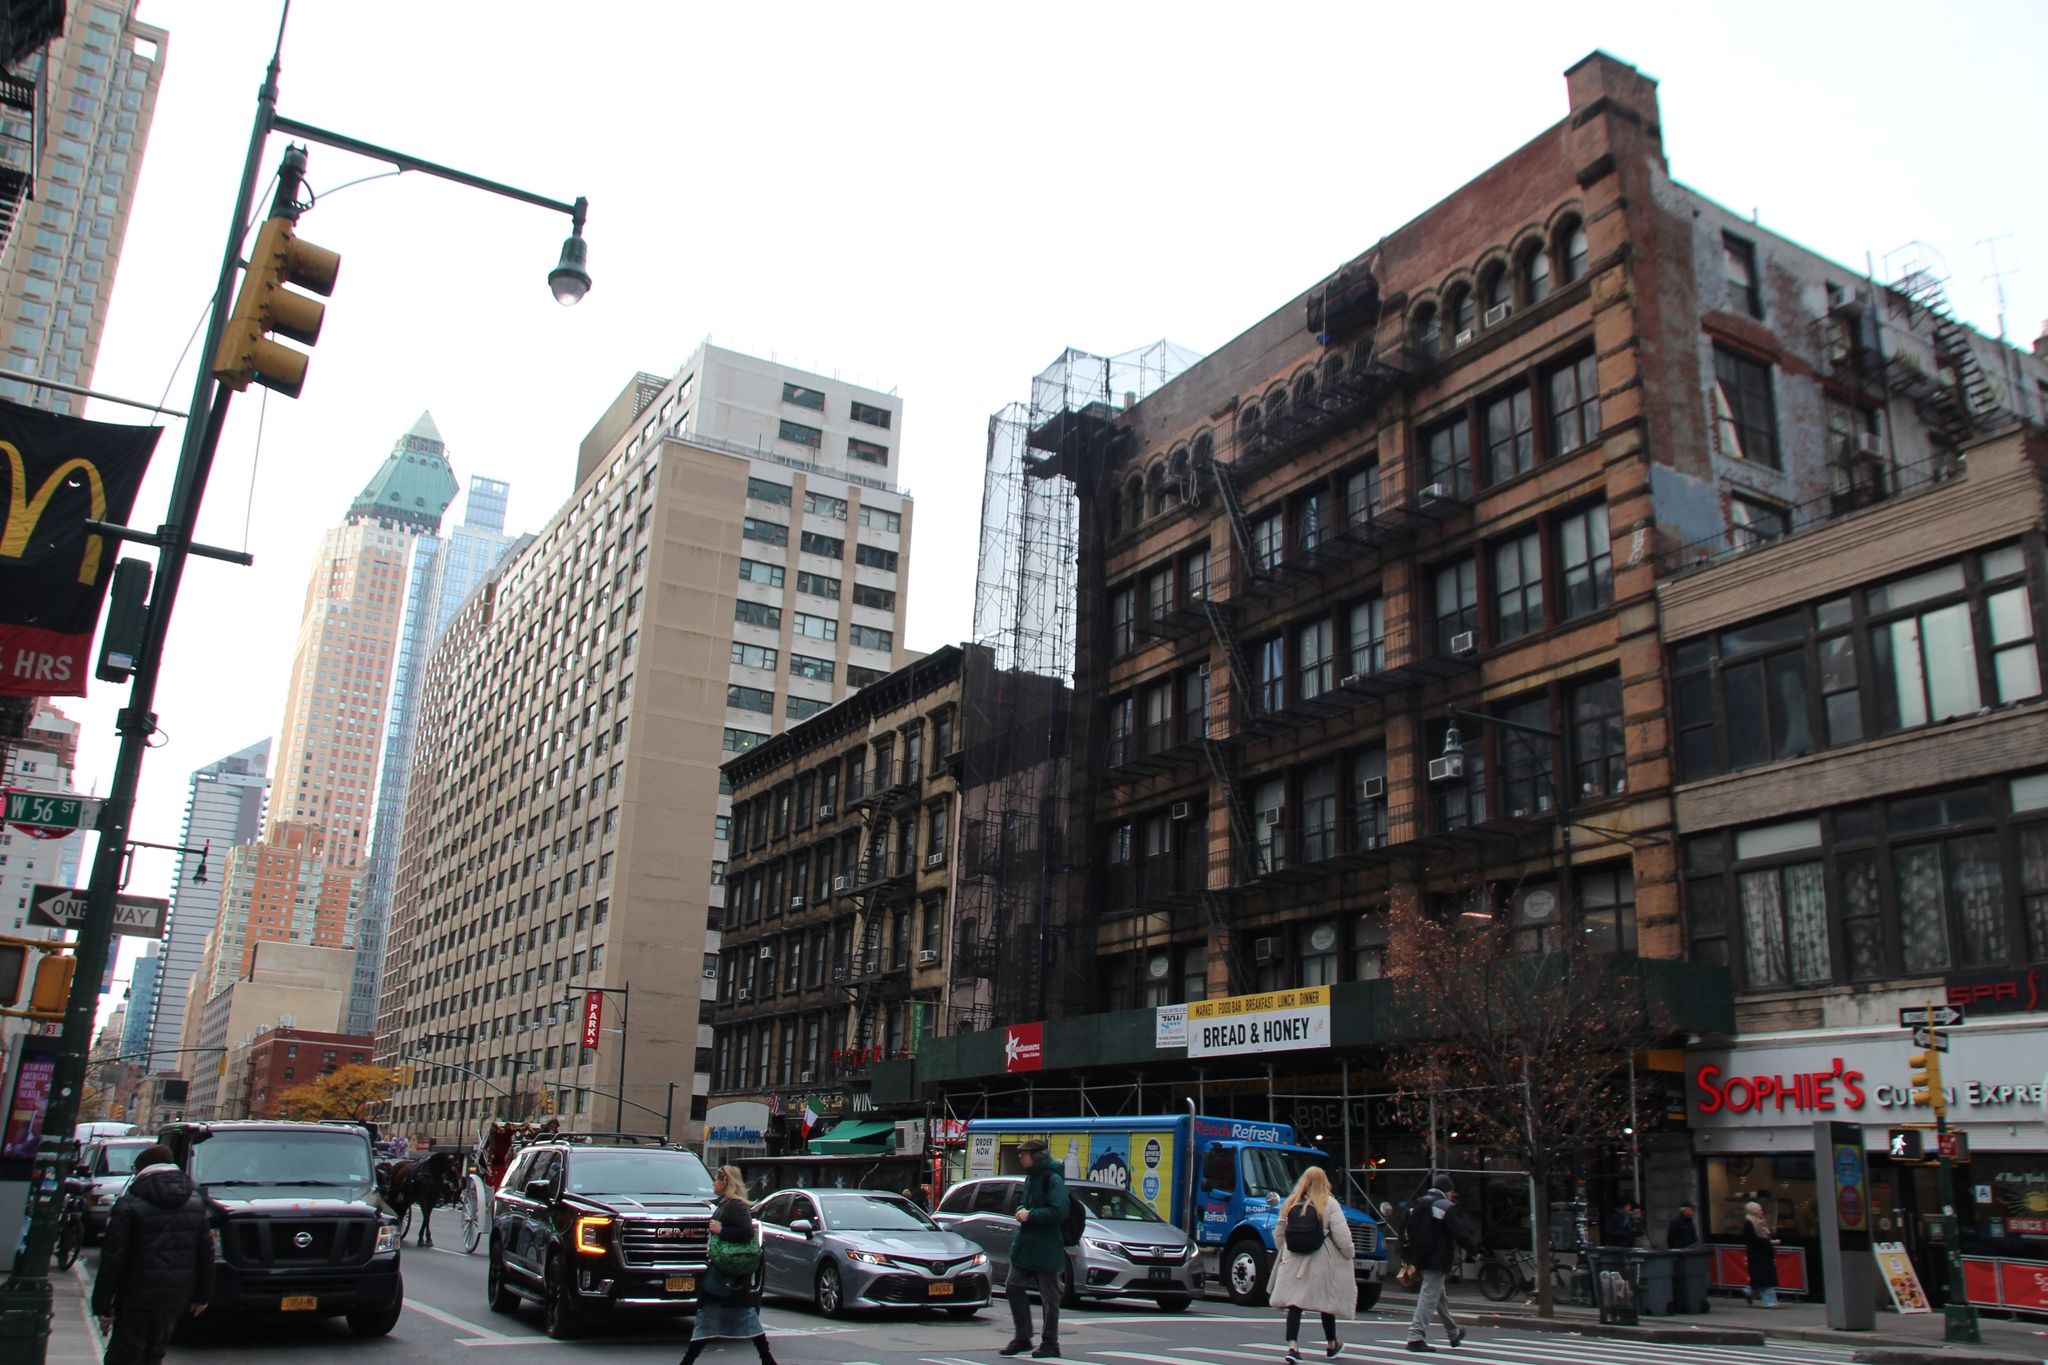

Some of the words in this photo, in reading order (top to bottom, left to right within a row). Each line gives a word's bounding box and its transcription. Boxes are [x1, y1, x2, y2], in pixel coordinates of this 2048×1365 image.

[13, 649, 73, 681] HRS
[11, 796, 27, 819] W
[32, 799, 55, 822] 56
[62, 801, 77, 814] ST
[1195, 1003, 1213, 1016] MARKET
[1218, 1001, 1231, 1015] FOOD
[1232, 1000, 1242, 1012] BAR
[1246, 996, 1274, 1012] BREAKFAST
[1278, 994, 1295, 1008] LUNCH
[1300, 991, 1320, 1005] DINNER
[1950, 982, 2017, 1005] SPA
[48, 1025, 55, 1035] 3
[588, 1003, 598, 1037] PARK
[1203, 1024, 1246, 1048] BREAD
[1250, 1022, 1260, 1044] &
[1264, 1017, 1310, 1042] HONEY
[1696, 1058, 1866, 1114] SOPHIE'S
[975, 1138, 992, 1146] ORDER
[975, 1147, 990, 1155] NOW
[657, 1228, 706, 1238] GMC
